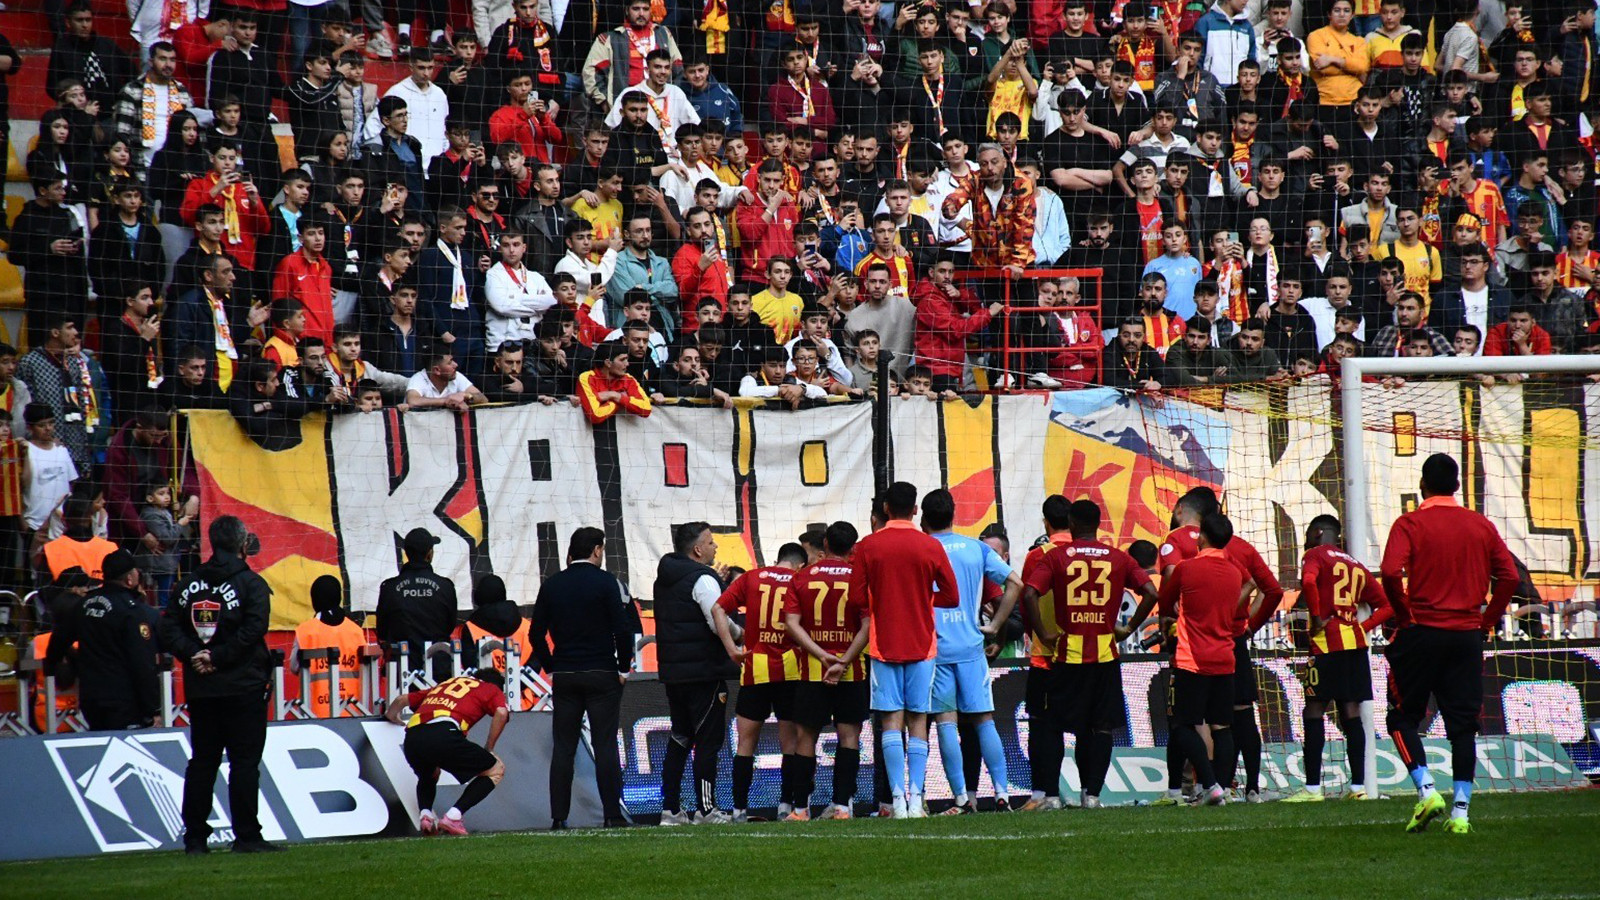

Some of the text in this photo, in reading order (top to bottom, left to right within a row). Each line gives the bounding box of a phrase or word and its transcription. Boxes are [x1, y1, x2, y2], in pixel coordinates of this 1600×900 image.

[415, 577, 441, 592] KUVVET
[1066, 560, 1112, 606] 23
[1333, 561, 1366, 606] 20
[808, 581, 850, 627] 77
[1071, 611, 1106, 624] CAROLE
[759, 631, 785, 644] ERAY
